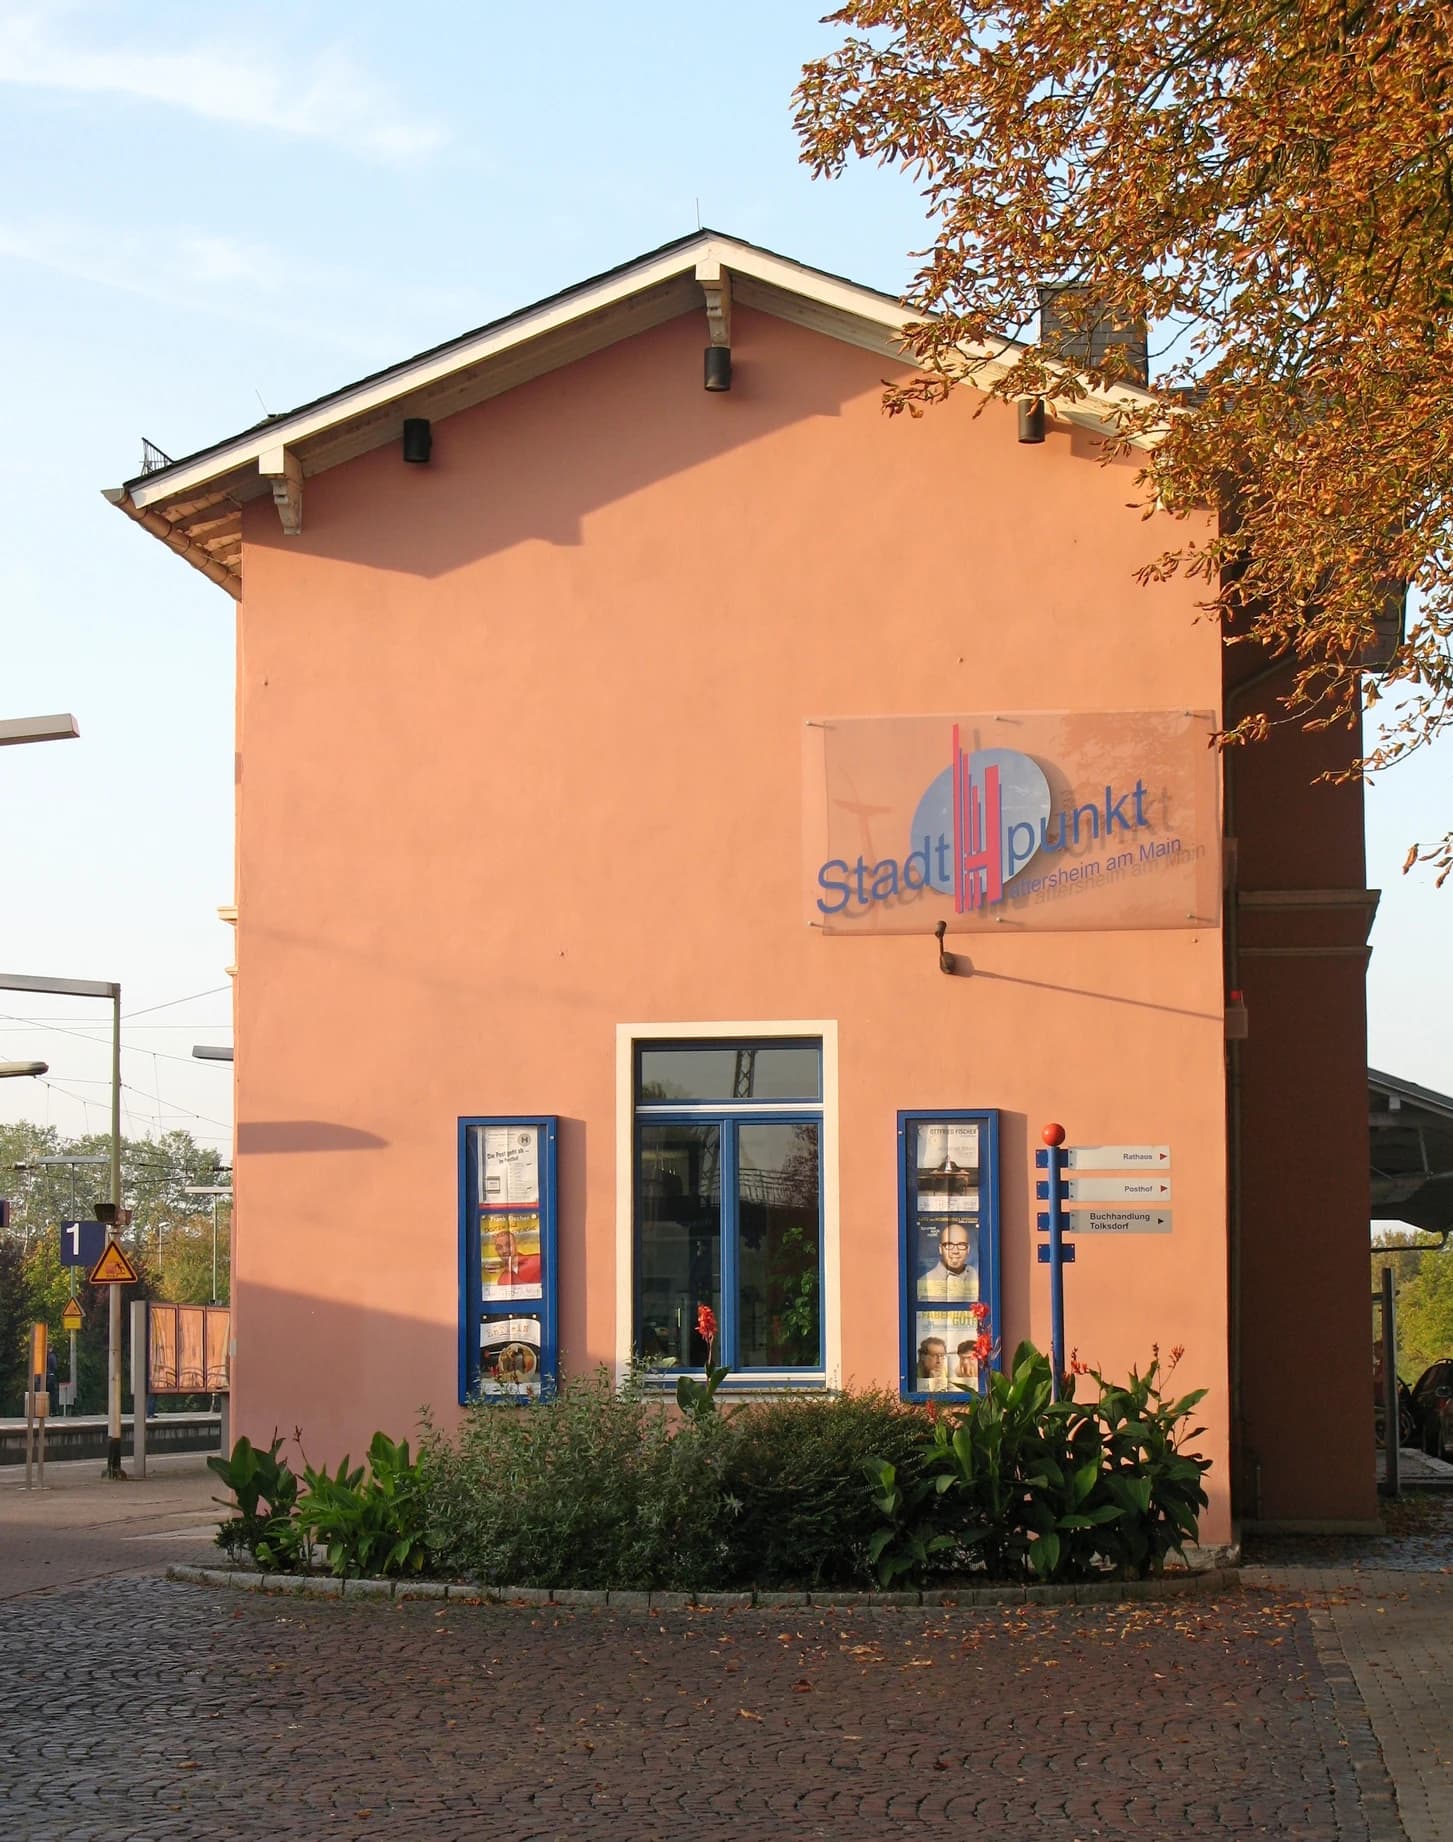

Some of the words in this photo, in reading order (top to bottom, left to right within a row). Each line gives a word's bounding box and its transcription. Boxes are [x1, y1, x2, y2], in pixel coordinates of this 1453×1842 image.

[817, 835, 950, 914] Stadt
[1008, 779, 1147, 874] punkt
[1106, 851, 1133, 871] am
[1139, 838, 1181, 860] Main
[1089, 1212, 1151, 1221] Buchhandlung
[1089, 1222, 1129, 1230] Tolksdorf
[66, 1222, 80, 1256] 1
